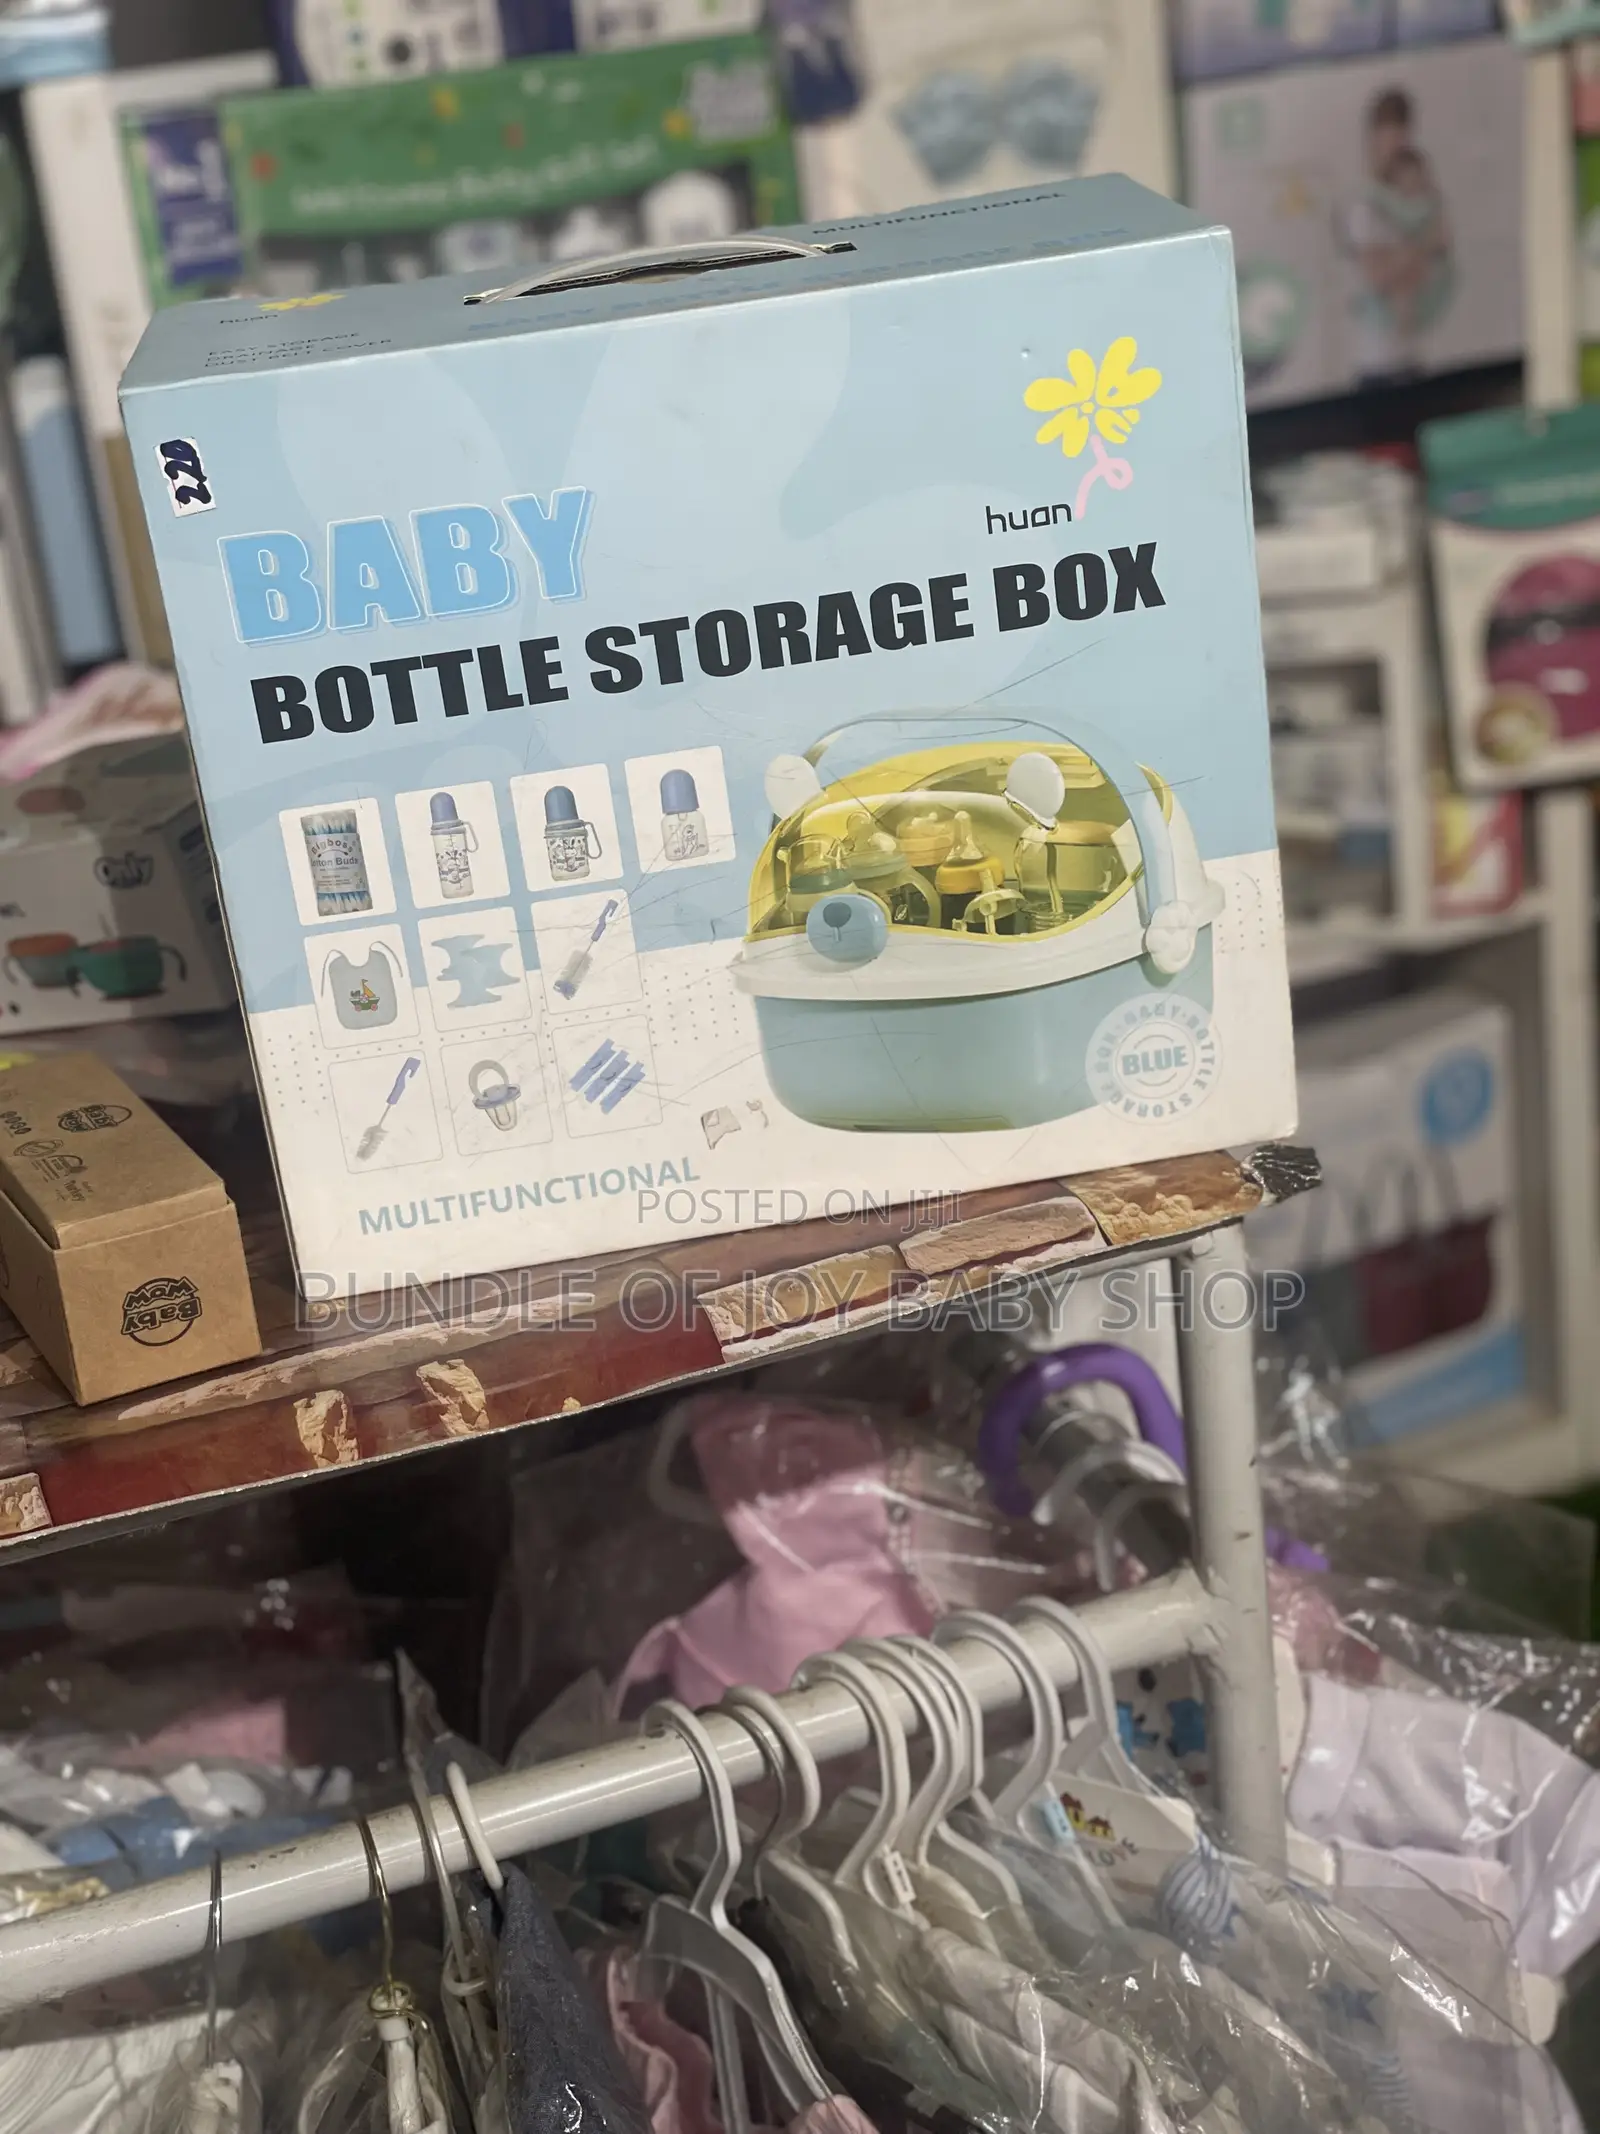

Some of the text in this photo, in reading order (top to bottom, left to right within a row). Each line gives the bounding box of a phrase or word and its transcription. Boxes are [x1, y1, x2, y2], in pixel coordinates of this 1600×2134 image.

[812, 192, 1067, 234] MULTIFUNCTIONAL
[985, 502, 1073, 535] huan
[217, 486, 596, 648] BABY
[250, 541, 1167, 744] BOTTLE STORAGE BOX
[1122, 1045, 1188, 1076] BLUE
[358, 1156, 701, 1236] MULTIFUNCTIONAL
